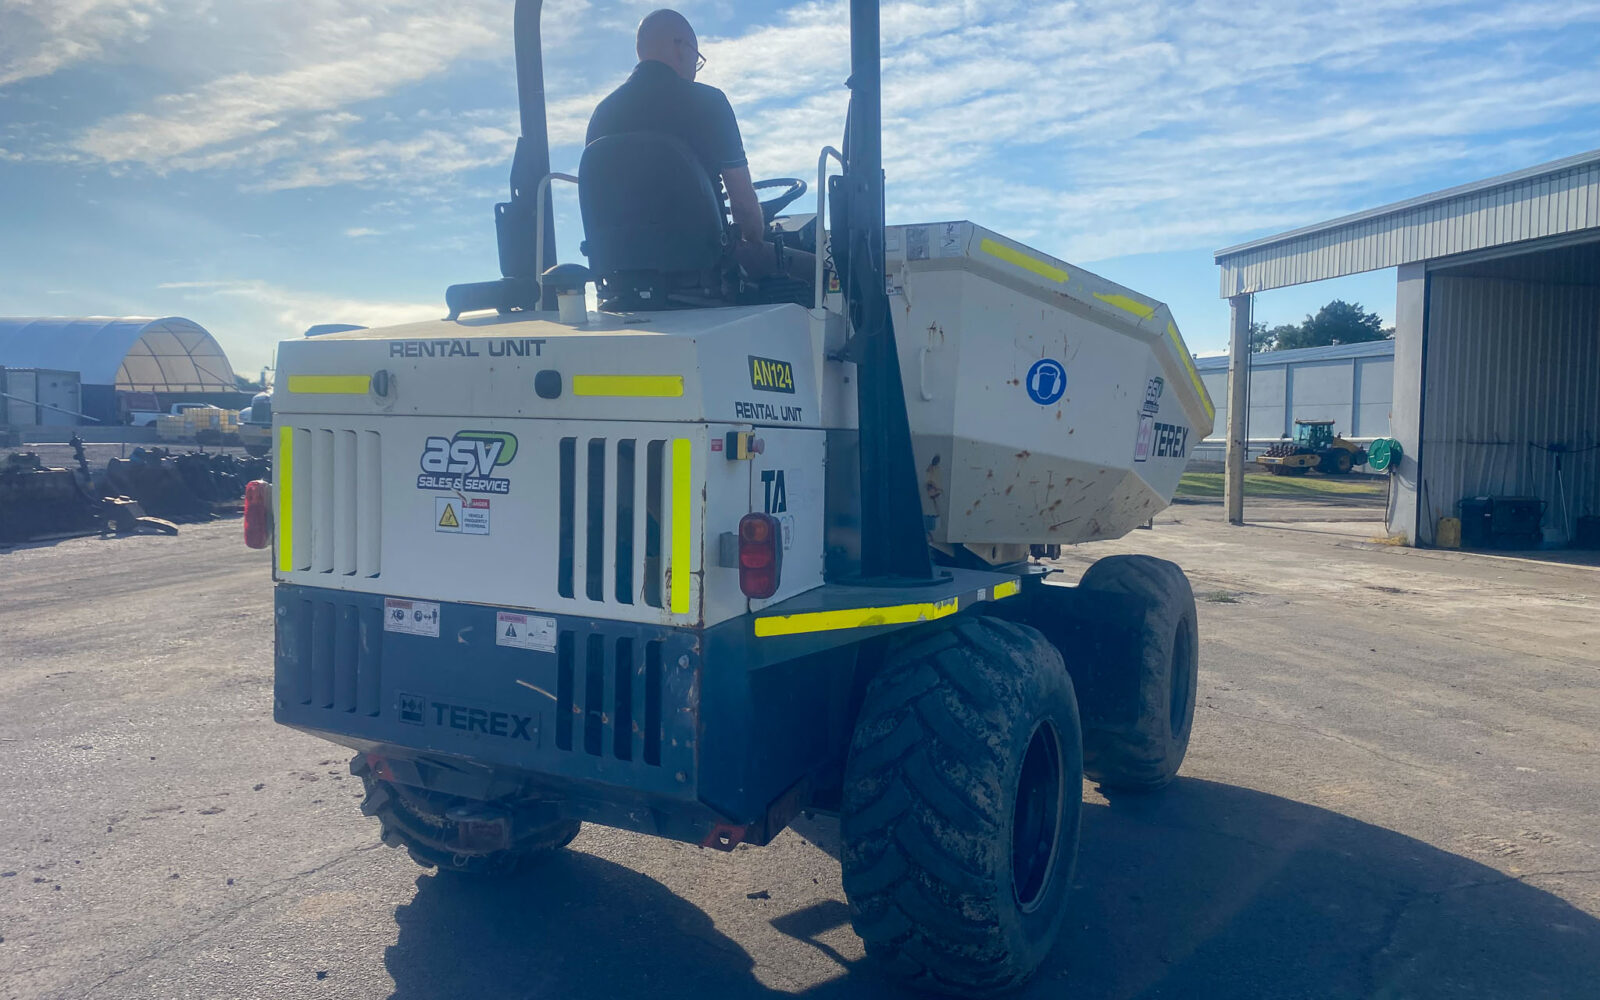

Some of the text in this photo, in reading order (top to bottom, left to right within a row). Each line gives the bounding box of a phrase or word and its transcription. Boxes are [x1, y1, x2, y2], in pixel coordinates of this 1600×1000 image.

[389, 339, 547, 358] RENTAL UNIT
[753, 359, 793, 389] AN124
[735, 401, 802, 421] RENTAL UNIT
[1152, 422, 1189, 458] TEREX
[453, 478, 462, 489] &
[464, 479, 509, 492] SERVICE
[430, 702, 532, 741] TEREX
